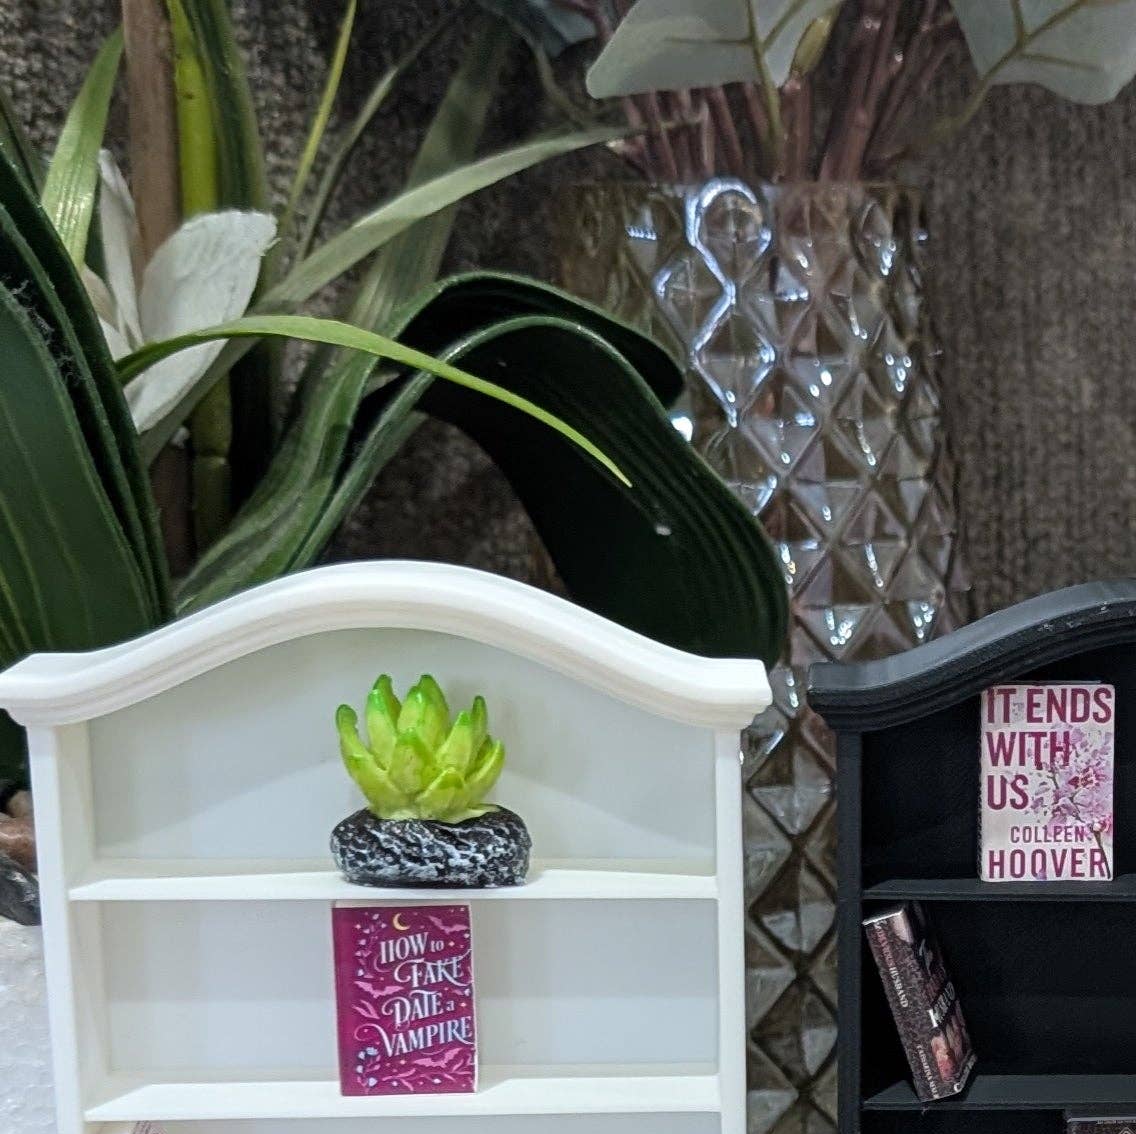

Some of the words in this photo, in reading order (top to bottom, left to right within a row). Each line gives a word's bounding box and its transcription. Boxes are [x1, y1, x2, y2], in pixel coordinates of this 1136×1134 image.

[987, 688, 1016, 723] IT
[1027, 688, 1112, 723] ENDS
[986, 731, 1070, 768] WITH
[987, 774, 1028, 810] US
[1011, 825, 1084, 843] COLLEEN
[989, 849, 1107, 878] HOOVER
[378, 932, 429, 964] HOW
[431, 939, 444, 953] to
[394, 956, 467, 988] FAKE
[382, 990, 443, 1027] DATE
[446, 1000, 455, 1012] a
[355, 1016, 474, 1057] VAMPIRE
